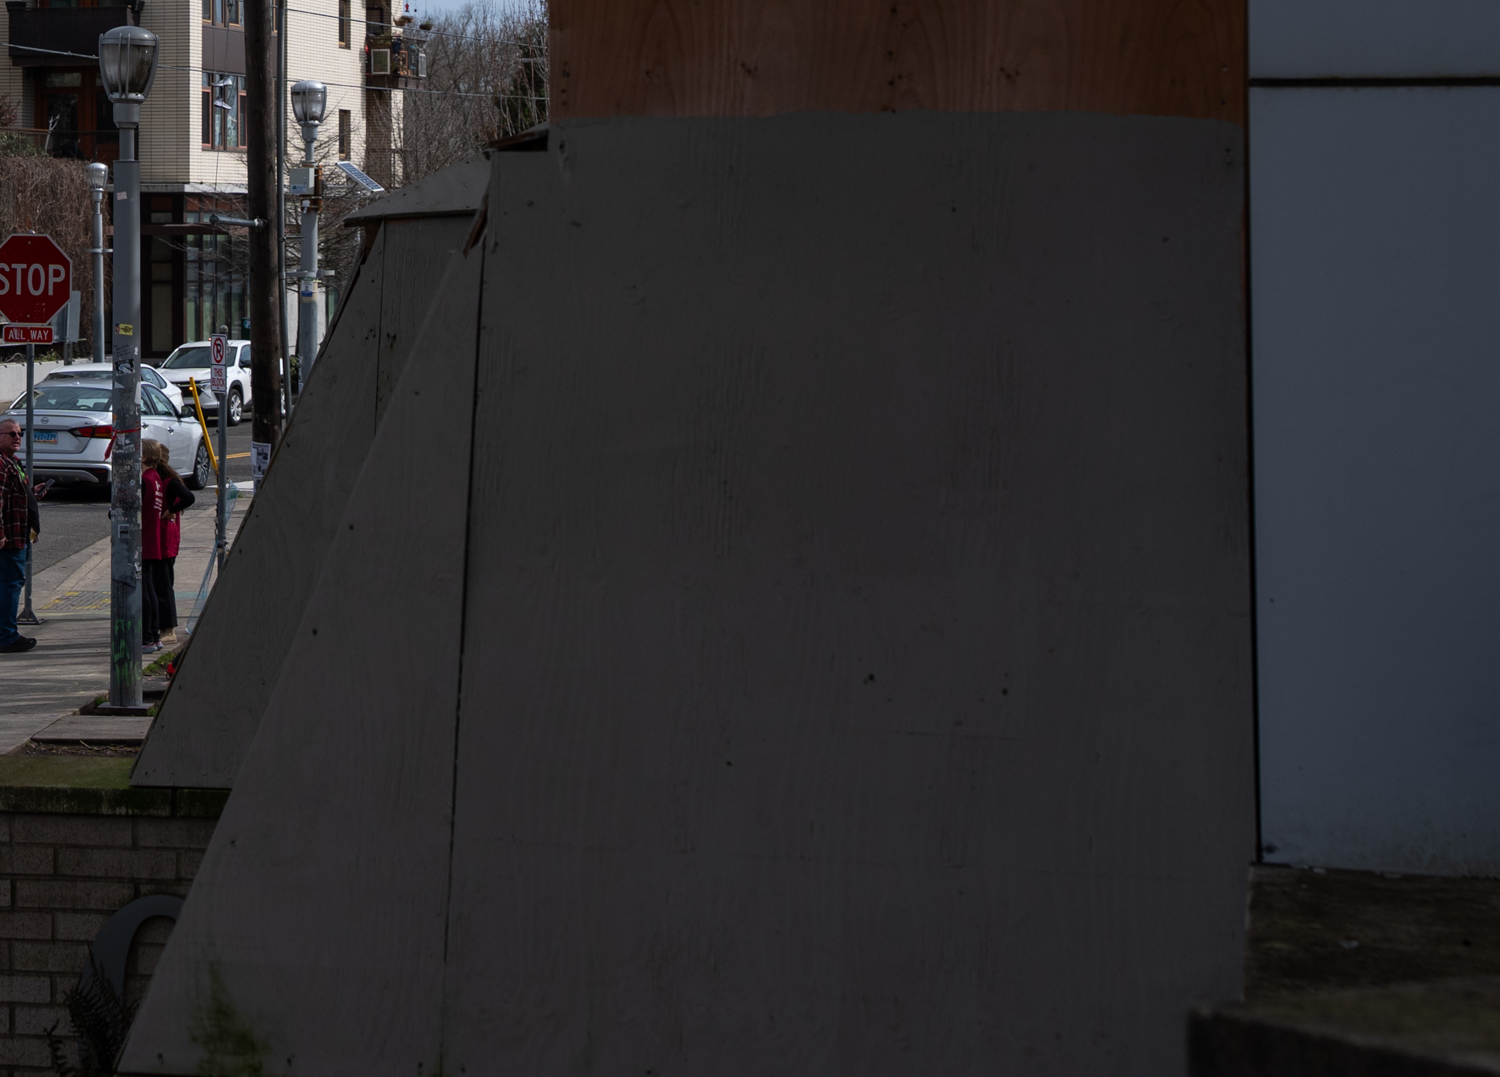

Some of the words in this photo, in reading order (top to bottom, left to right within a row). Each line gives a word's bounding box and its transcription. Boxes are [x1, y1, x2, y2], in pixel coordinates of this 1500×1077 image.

[8, 329, 26, 340] ALL
[30, 329, 49, 340] WAY
[214, 368, 223, 377] THIS
[212, 378, 225, 387] BLOCK
